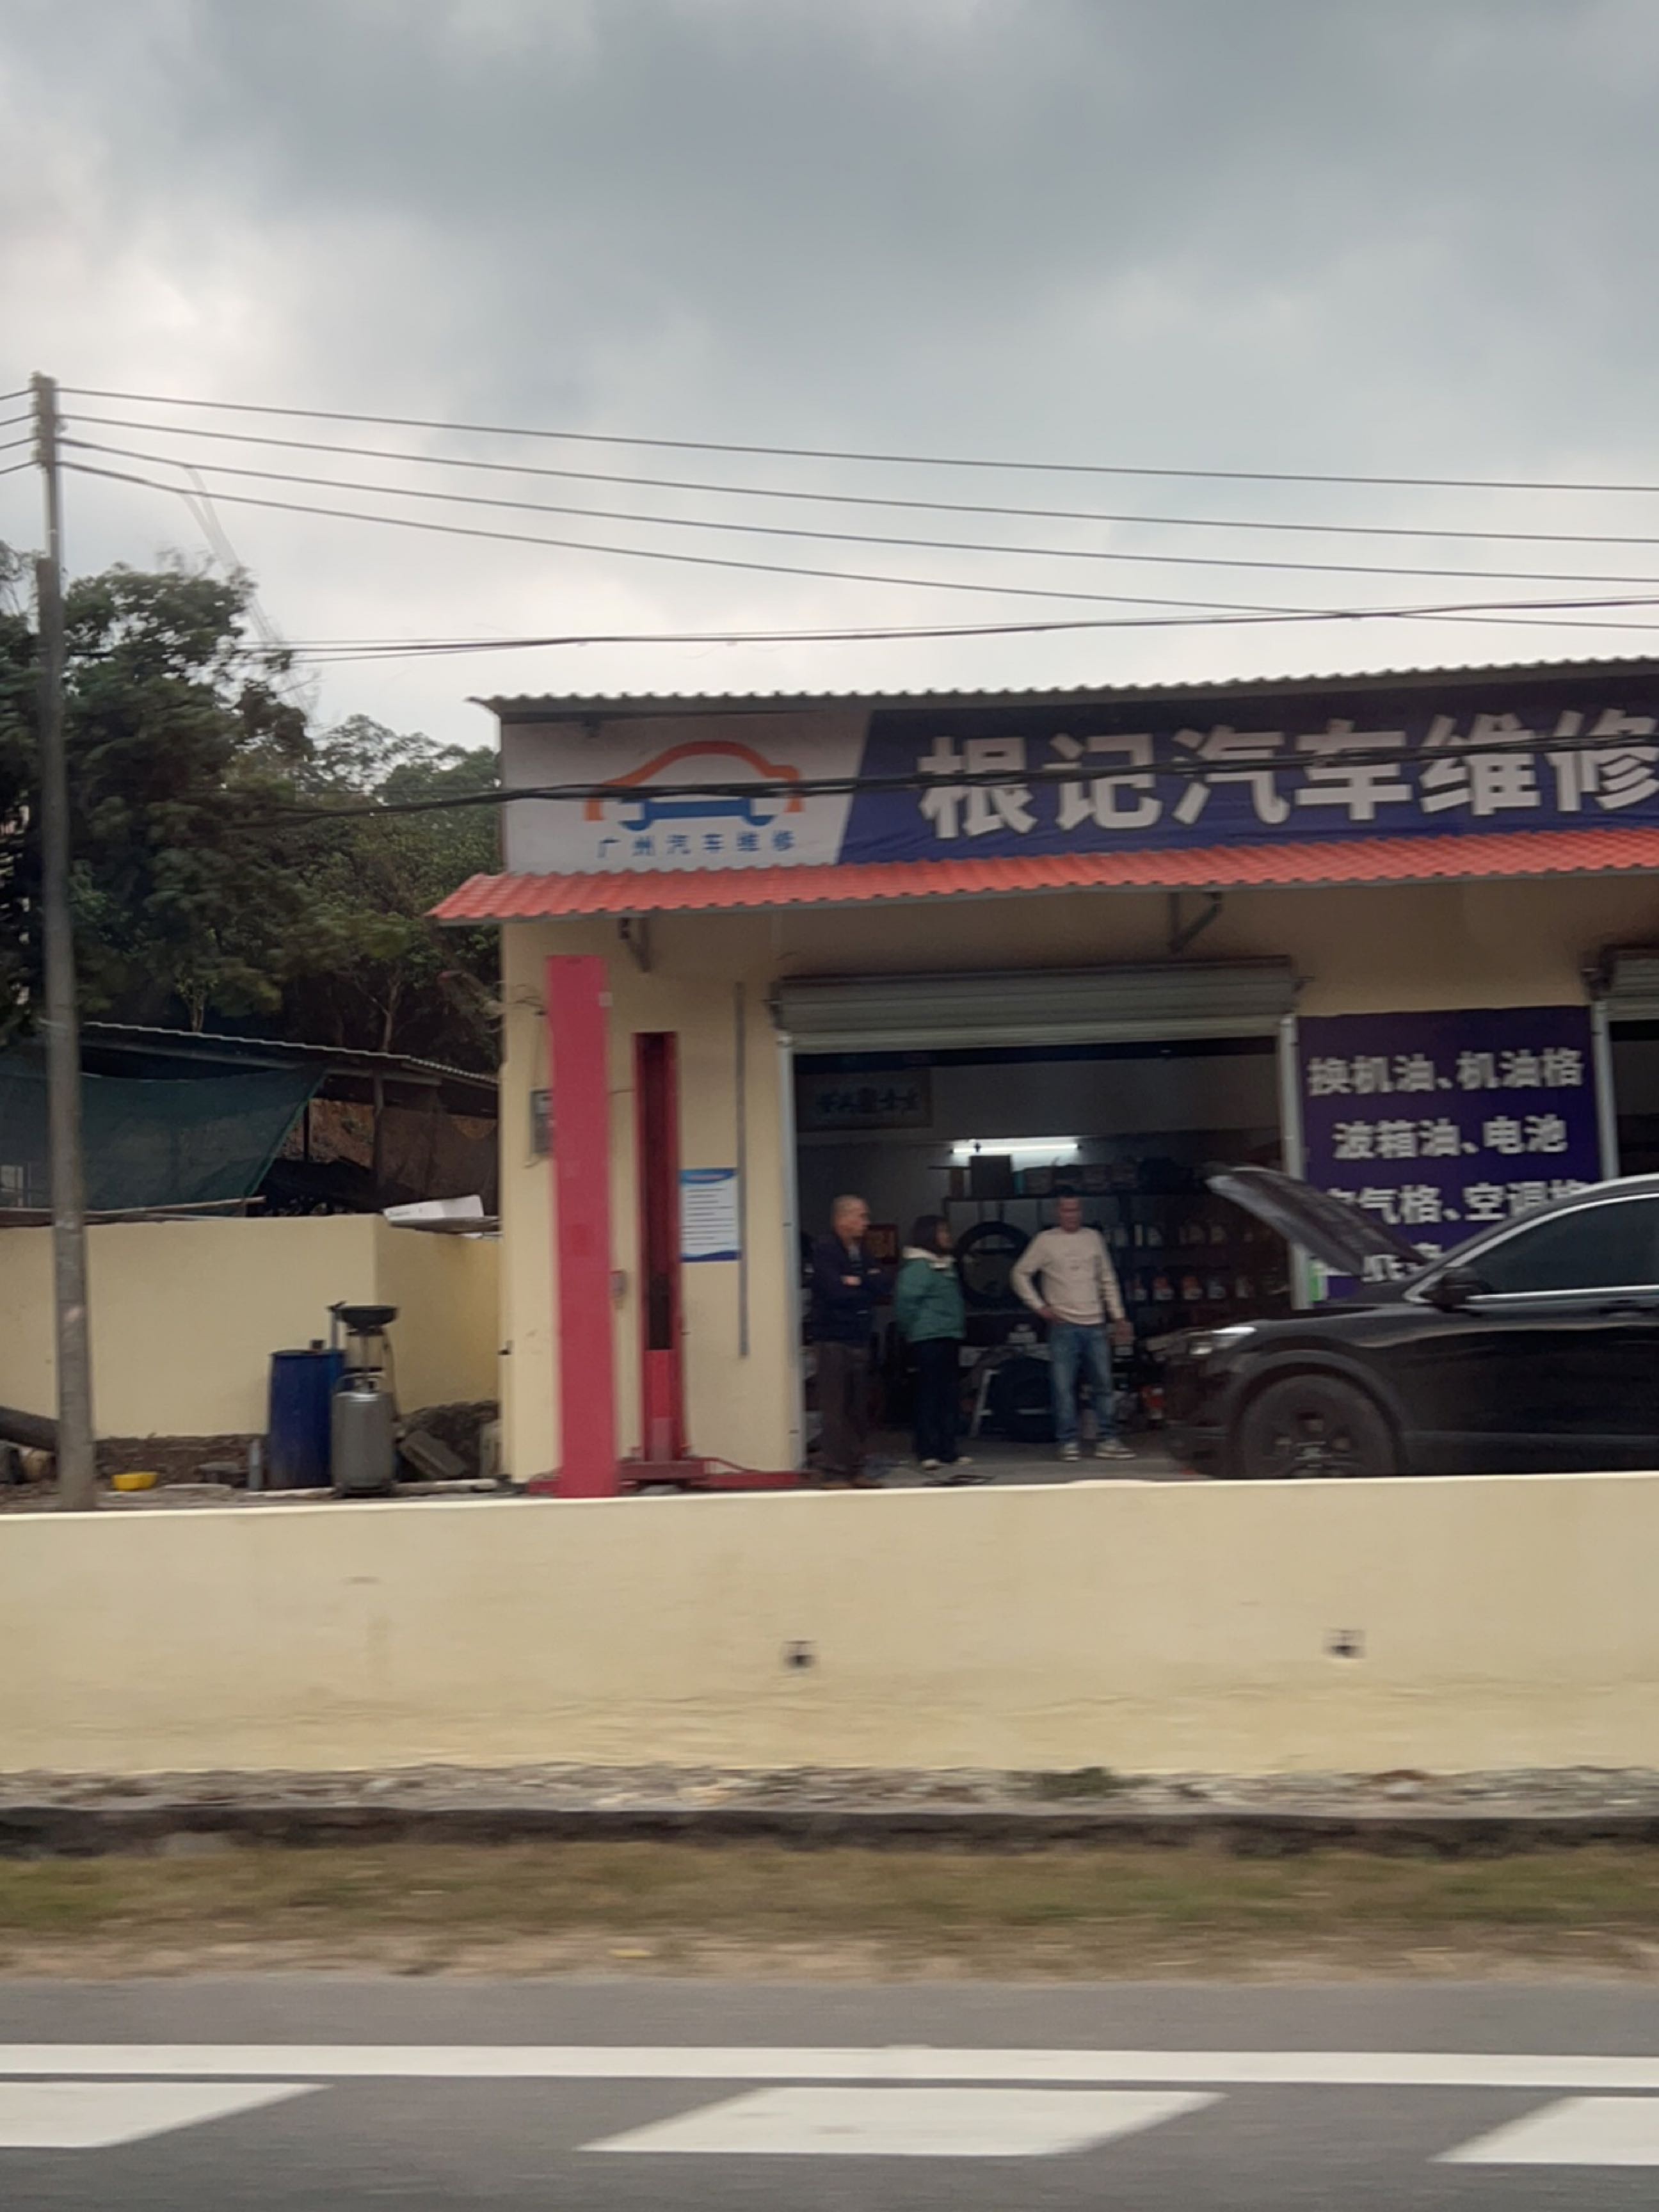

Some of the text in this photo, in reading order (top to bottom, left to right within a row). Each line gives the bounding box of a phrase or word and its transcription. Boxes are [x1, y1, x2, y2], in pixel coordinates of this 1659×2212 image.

[918, 708, 1659, 839] 根记汽车维修
[1308, 1048, 1584, 1096] 换机油、机油格
[1333, 1114, 1568, 1160] 波箱油、电池
